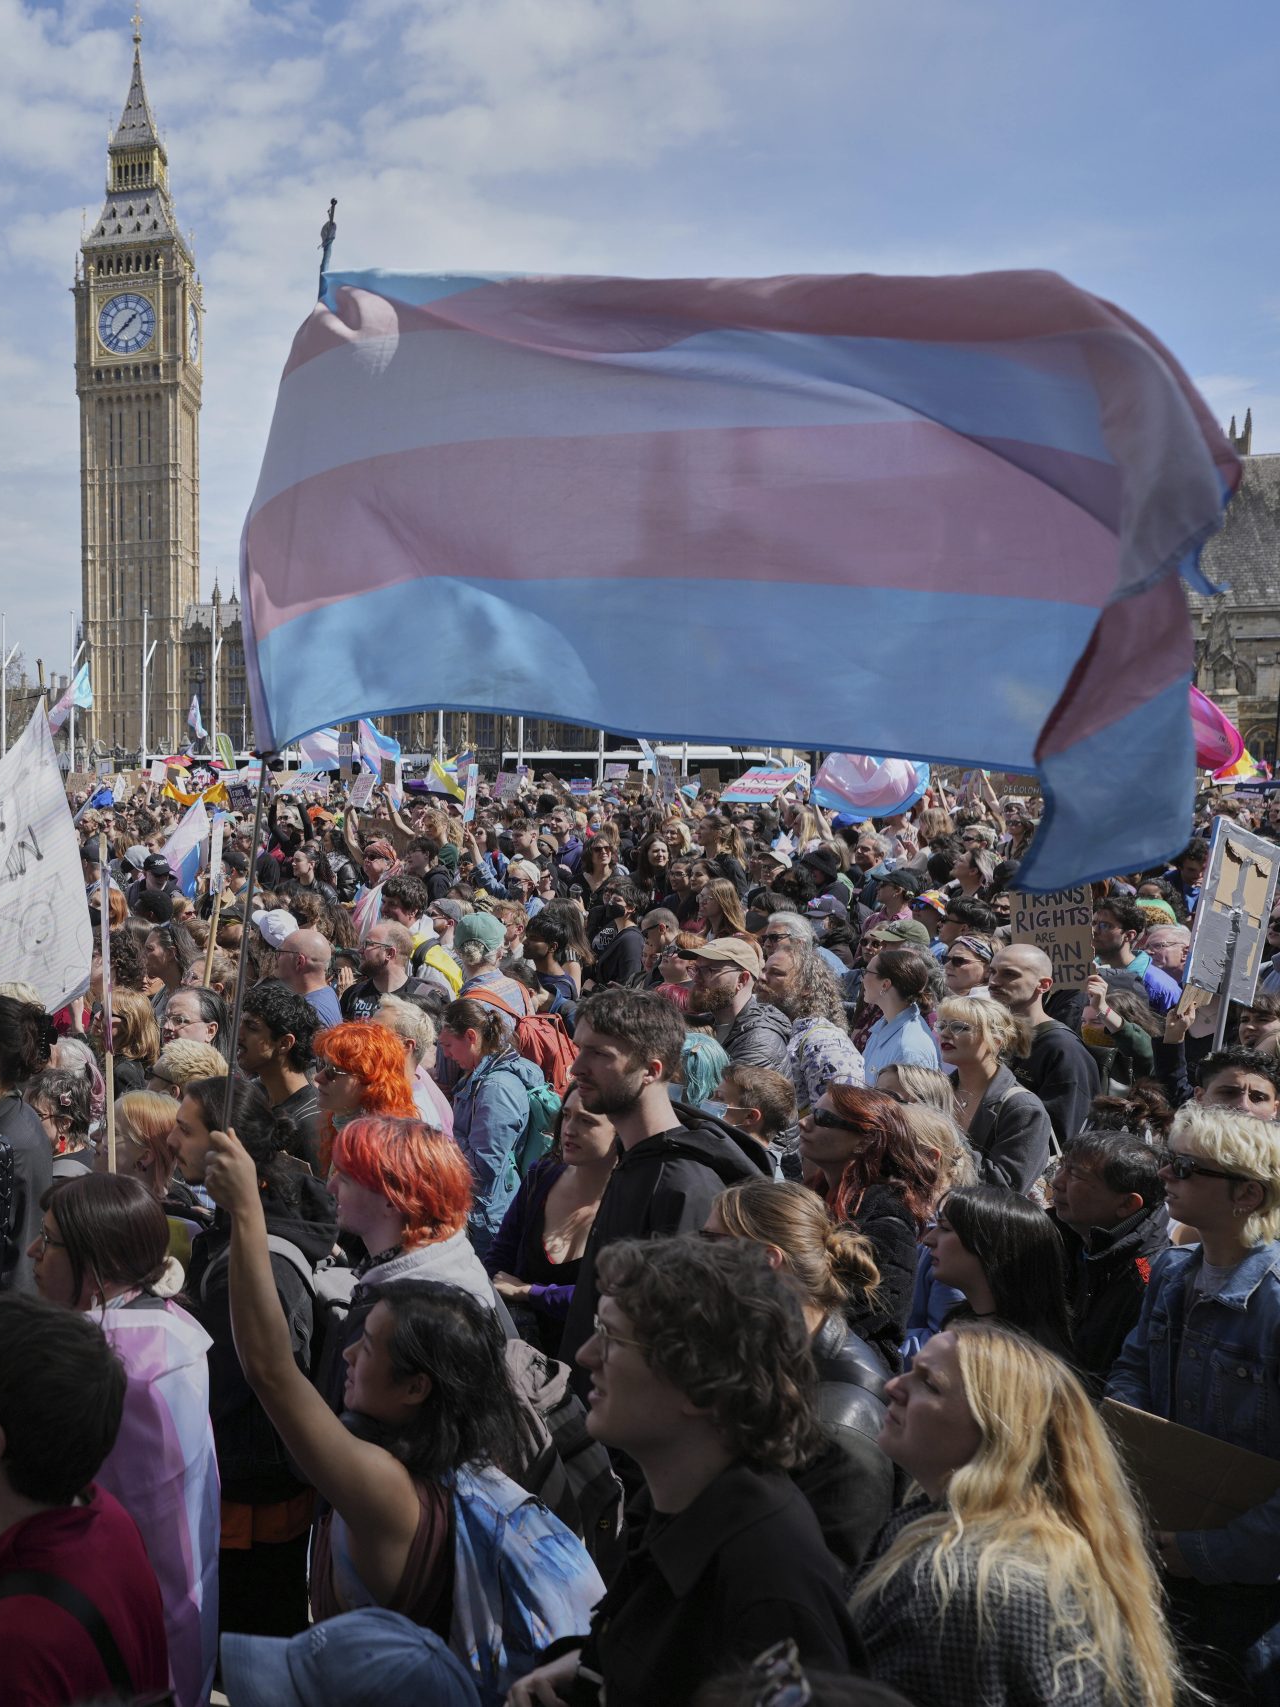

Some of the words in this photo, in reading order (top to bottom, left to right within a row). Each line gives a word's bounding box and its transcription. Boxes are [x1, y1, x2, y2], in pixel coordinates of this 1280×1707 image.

[1016, 887, 1085, 910] TRANS
[1015, 906, 1090, 934] RIGHTS
[1035, 932, 1056, 944] ARE
[354, 1001, 373, 1011] YOU
